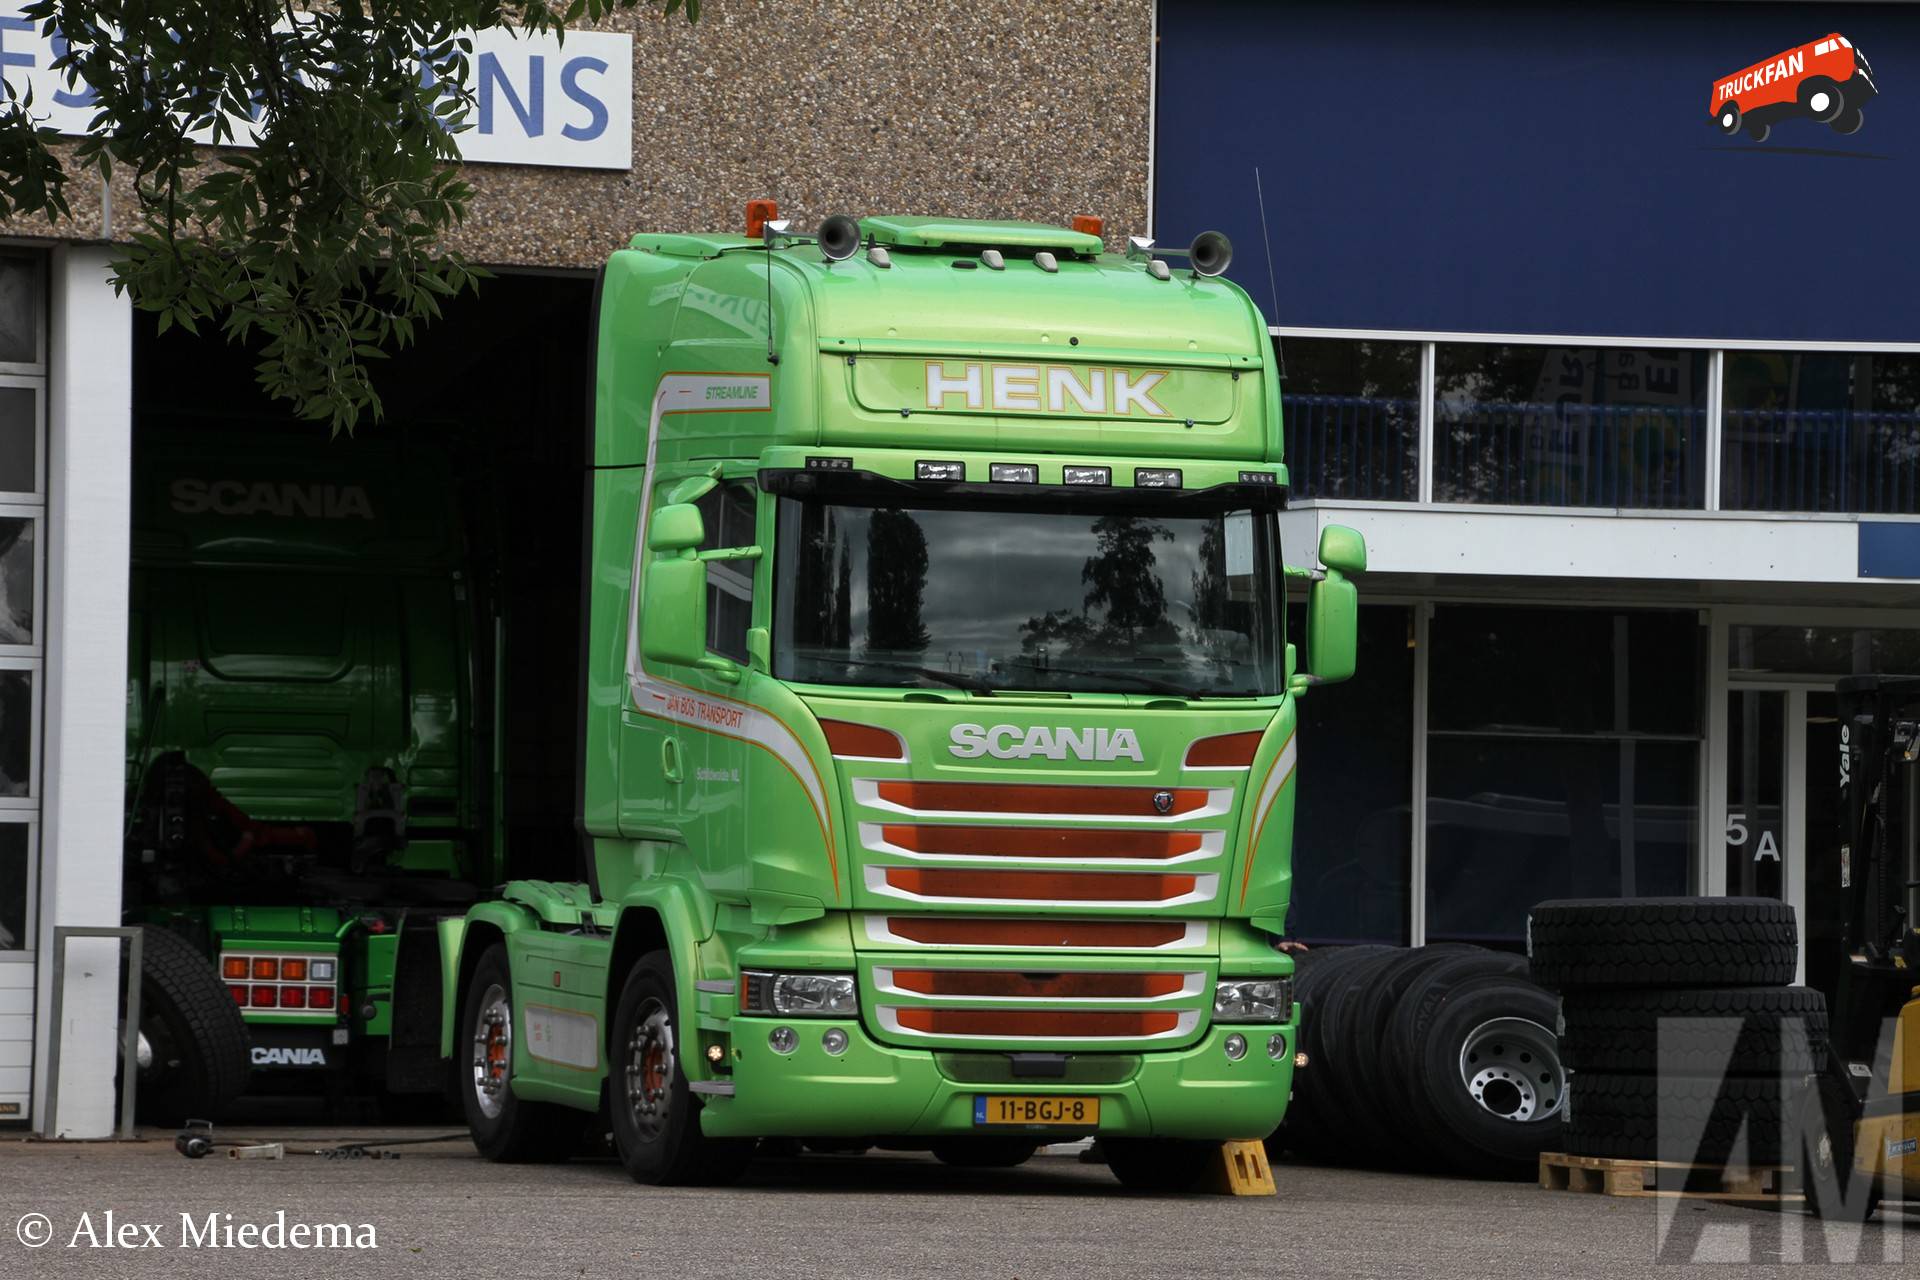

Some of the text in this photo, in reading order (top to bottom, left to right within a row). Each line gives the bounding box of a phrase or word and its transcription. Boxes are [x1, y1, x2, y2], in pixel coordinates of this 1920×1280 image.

[705, 386, 759, 400] STREAMLINE
[925, 361, 1174, 418] HENK
[169, 478, 375, 519] SCANIA
[681, 697, 696, 718] BOS
[698, 702, 743, 728] TRANSPORT
[948, 723, 1145, 762] SCANIA
[1839, 724, 1850, 788] Yale
[1726, 813, 1781, 862] 5 A
[250, 1046, 326, 1065] CANIA
[999, 1101, 1085, 1120] 11-BGJ-8
